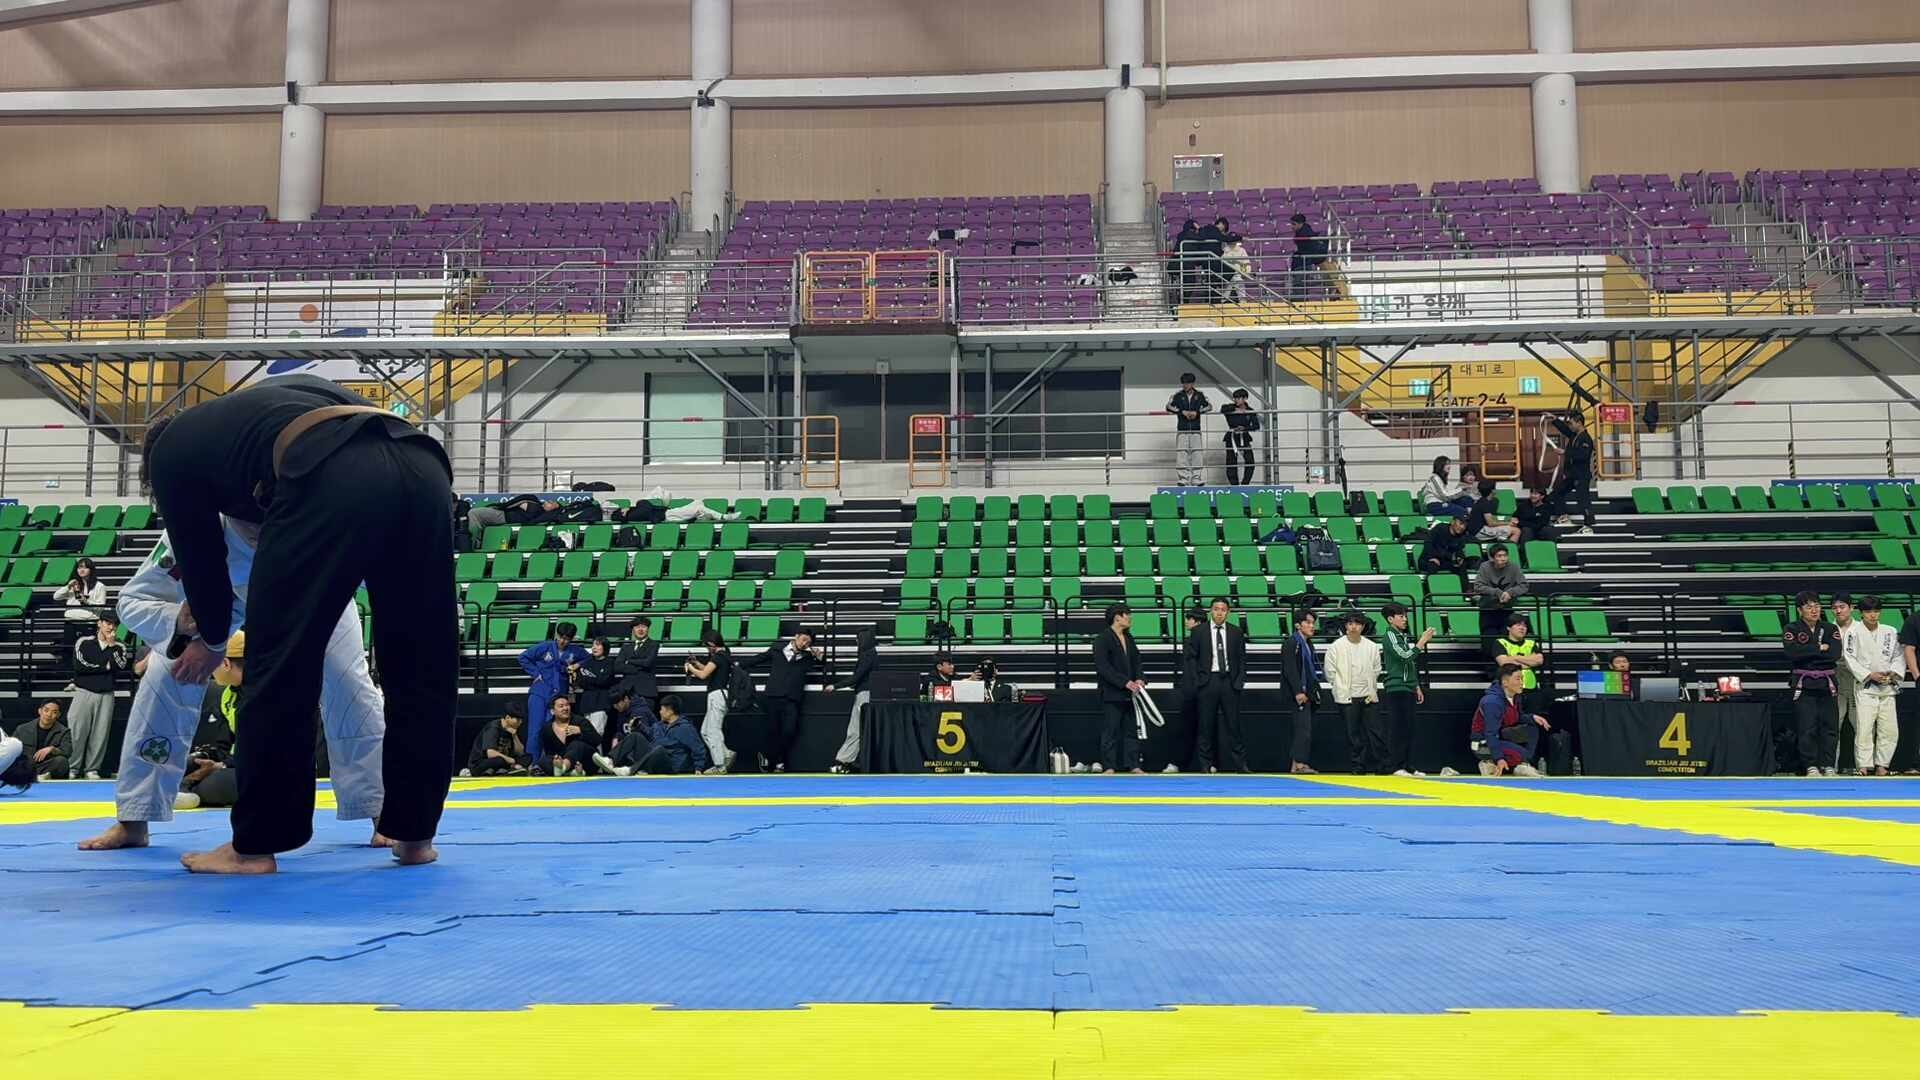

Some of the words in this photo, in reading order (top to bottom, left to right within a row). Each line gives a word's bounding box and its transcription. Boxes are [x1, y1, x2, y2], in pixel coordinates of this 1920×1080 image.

[1460, 364, 1505, 376] 대피로
[1441, 397, 1475, 407] GATE
[1478, 393, 1508, 406] 2-4
[936, 711, 966, 754] 5
[1659, 712, 1691, 755] 4
